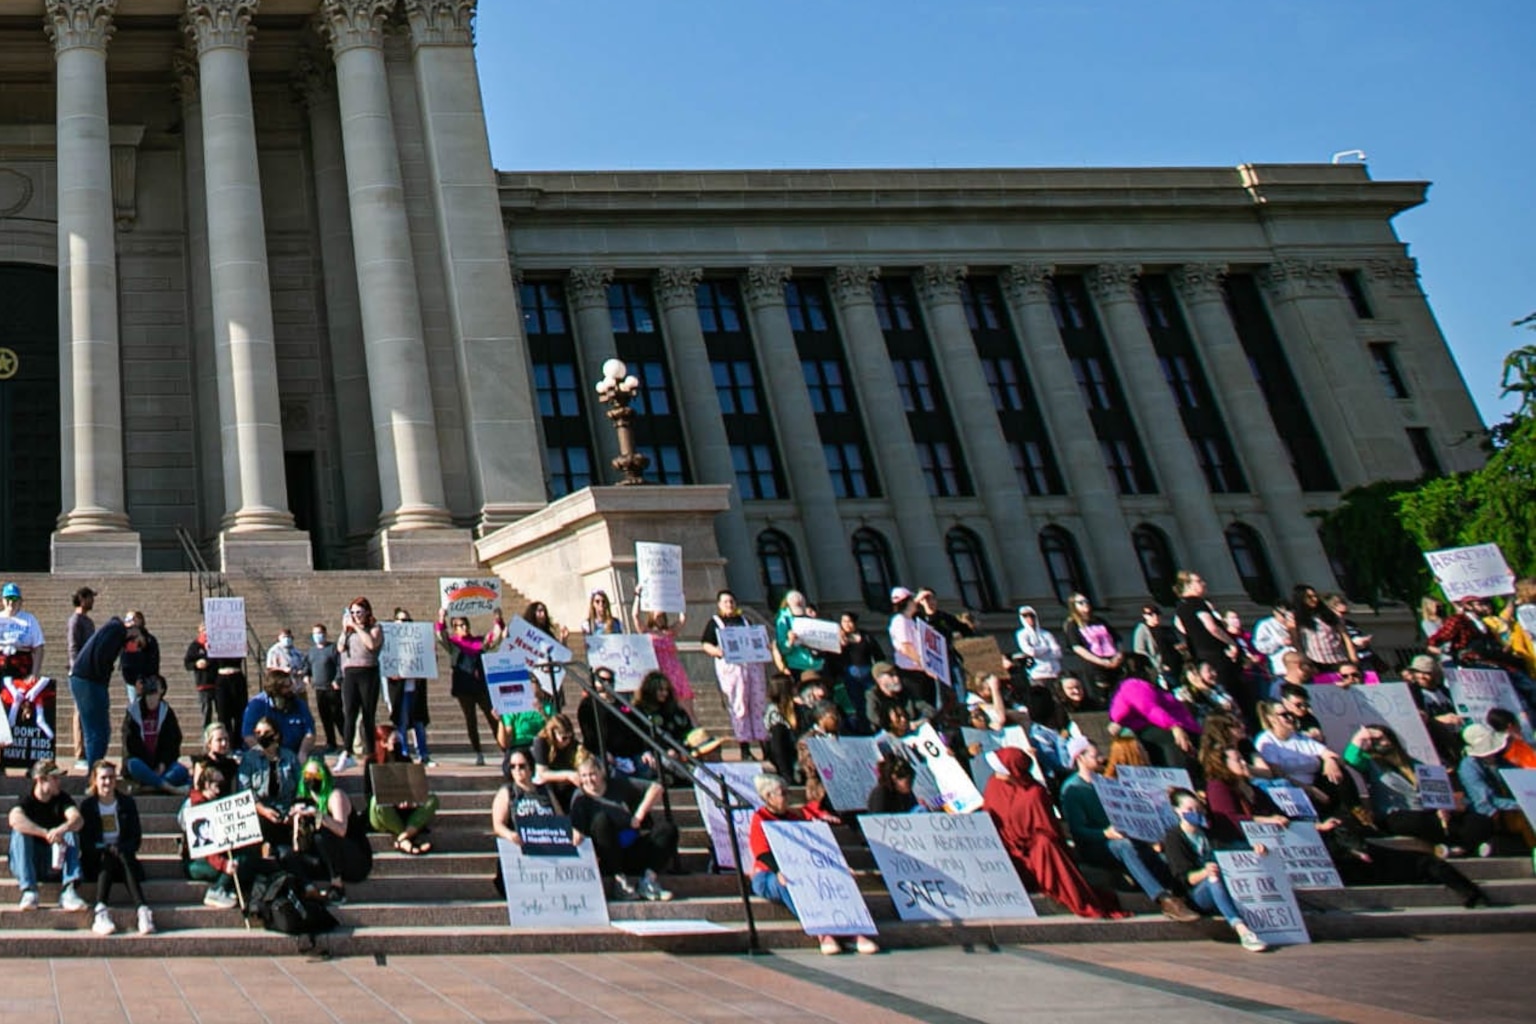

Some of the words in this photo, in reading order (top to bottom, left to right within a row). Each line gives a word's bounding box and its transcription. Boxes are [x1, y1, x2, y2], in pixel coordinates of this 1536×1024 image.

[382, 626, 423, 639] FOCUS
[403, 642, 424, 655] THE
[1315, 691, 1347, 717] NO
[14, 726, 41, 737] DON'T
[13, 737, 27, 747] AKE
[31, 738, 51, 749] KIDS
[5, 748, 26, 759] HAVE
[526, 827, 559, 836] Abortion
[527, 836, 553, 844] Health
[889, 836, 927, 851] BAN
[934, 835, 999, 851] ABORTION
[1230, 878, 1252, 894] OFF
[1256, 877, 1279, 894] OUR
[897, 879, 956, 908] SAFE
